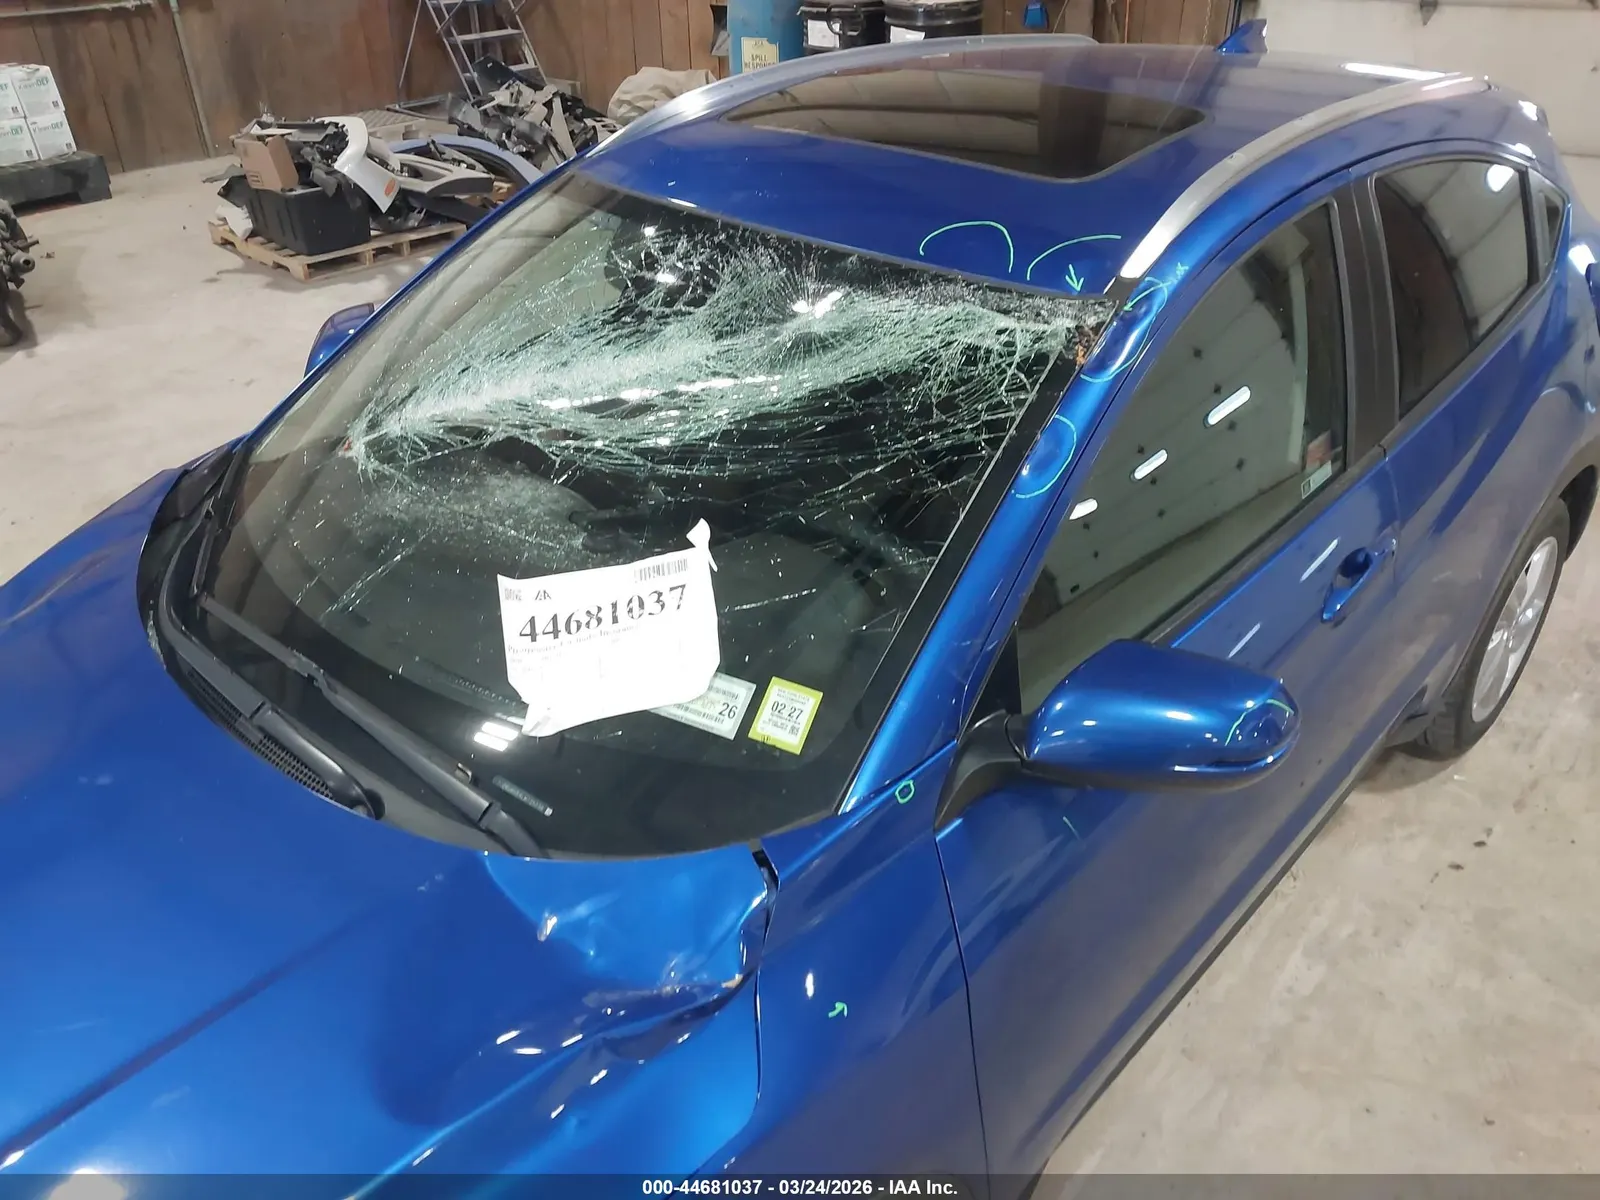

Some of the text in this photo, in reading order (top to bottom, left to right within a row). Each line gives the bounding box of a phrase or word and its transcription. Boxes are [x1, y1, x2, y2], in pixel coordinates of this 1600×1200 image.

[751, 54, 767, 62] SPILL
[519, 583, 686, 643] 44681037
[718, 702, 738, 719] 26
[771, 700, 804, 720] 02 27
